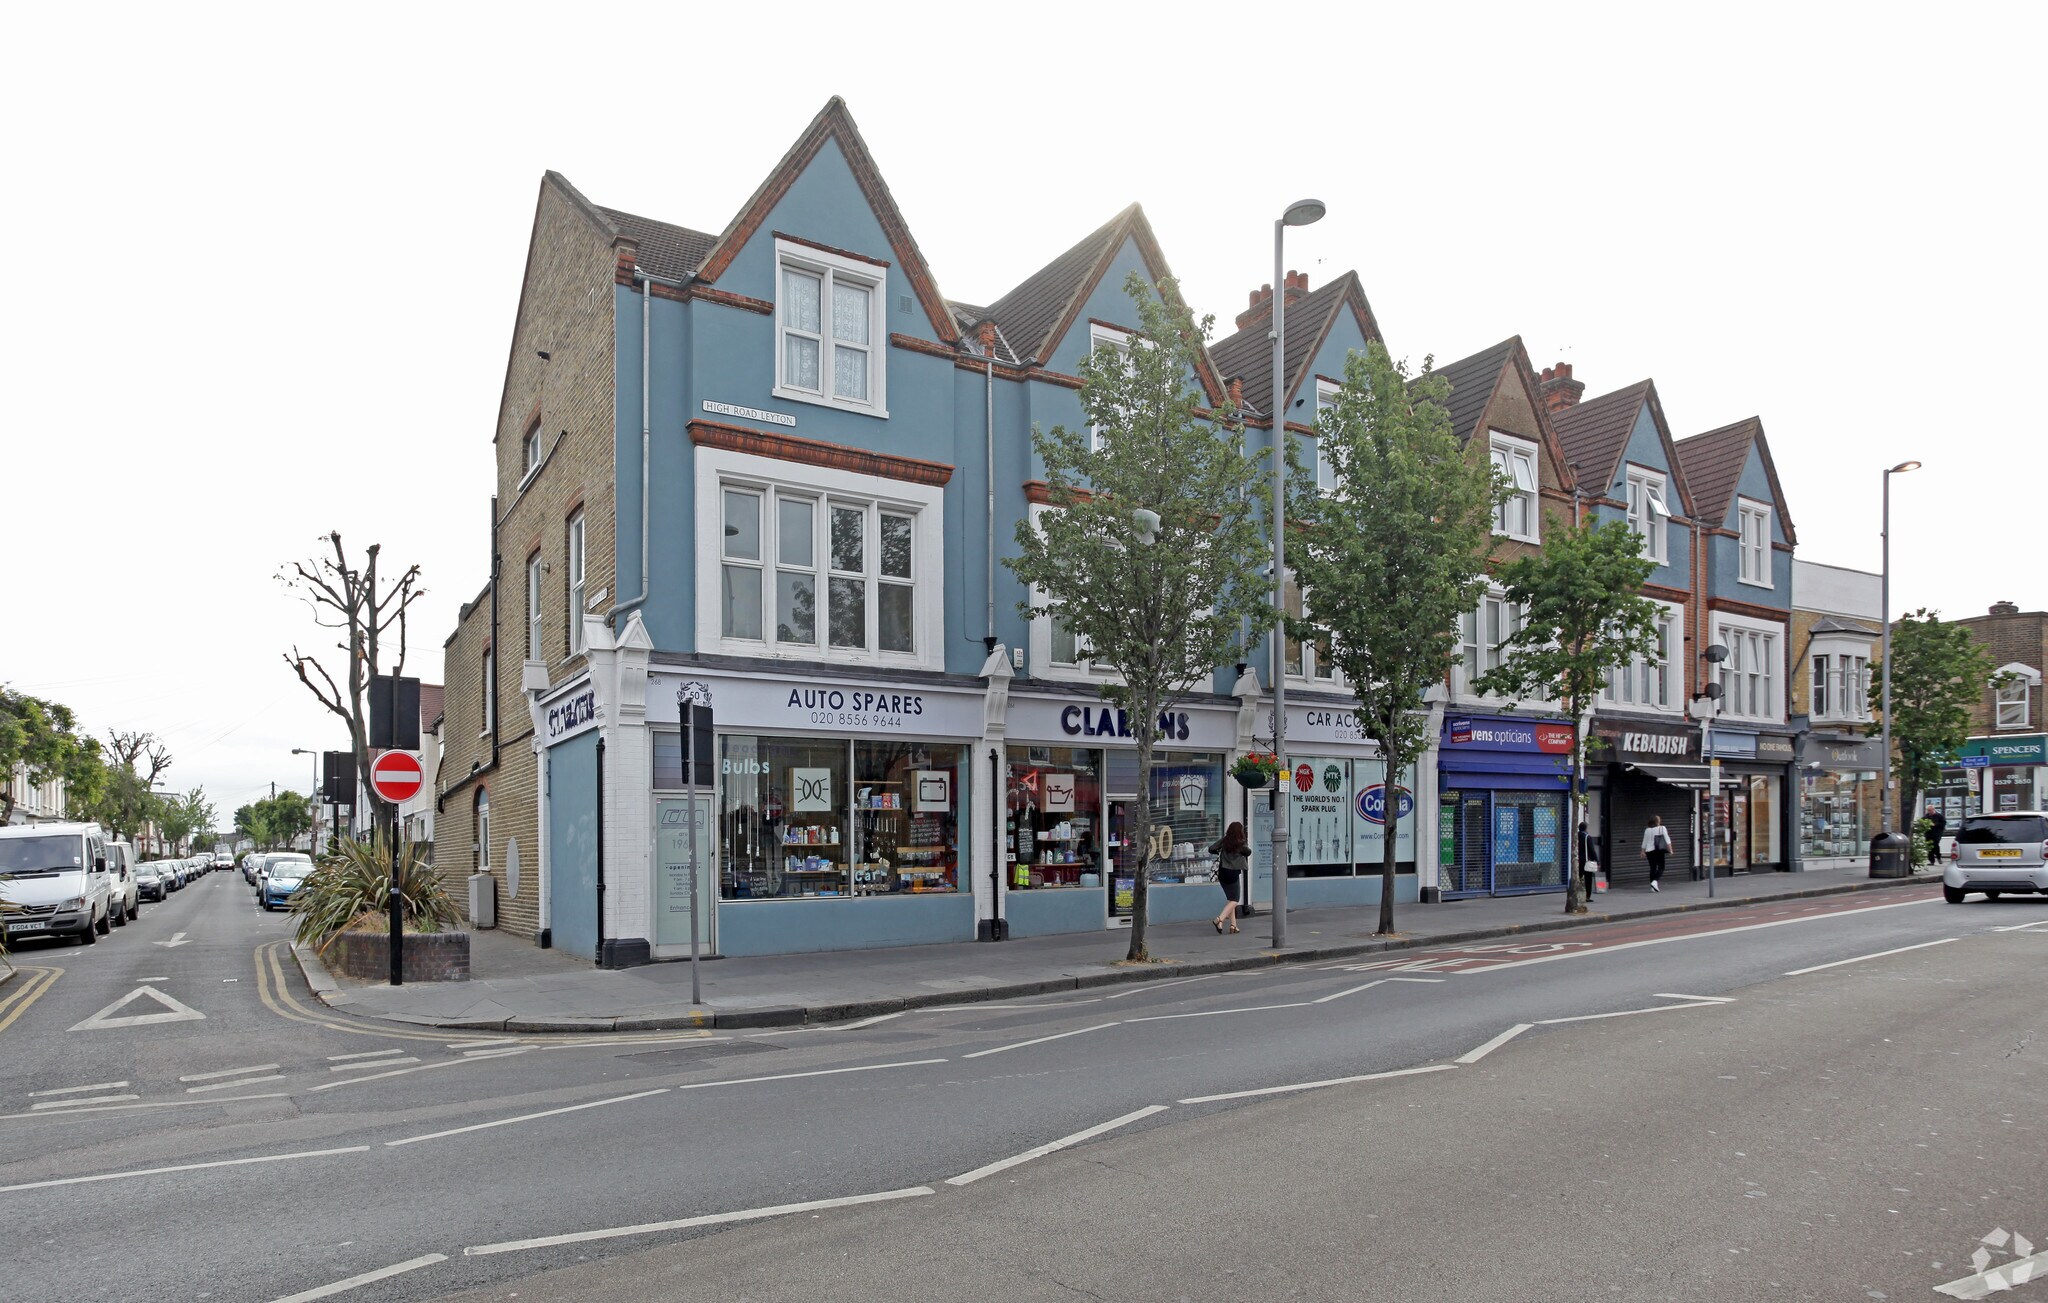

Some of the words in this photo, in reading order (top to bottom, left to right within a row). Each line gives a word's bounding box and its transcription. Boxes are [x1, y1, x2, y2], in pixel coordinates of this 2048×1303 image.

[706, 402, 730, 413] HIGH
[733, 406, 758, 418] ROAD
[761, 412, 793, 425] LEYTON
[690, 691, 700, 700] 50
[787, 688, 845, 710] AUTO
[852, 692, 923, 715] SPARES
[811, 711, 834, 724] 020
[838, 713, 868, 726] 8556
[872, 714, 901, 727] 9644
[1061, 704, 1190, 741] CLARNS
[1306, 711, 1331, 727] CAR
[1335, 730, 1348, 739] 020
[1471, 729, 1493, 741] vens
[1494, 729, 1532, 746] opticians
[1623, 732, 1688, 755] KEBABISH
[1992, 744, 2041, 755] SPENCERS
[722, 758, 770, 775] Bulbs
[1325, 771, 1340, 780] NTK
[1293, 795, 1304, 803] THE
[1304, 795, 1331, 803] WORLD'S
[1365, 794, 1409, 812] Coa
[1301, 805, 1320, 813] SPARK
[1321, 805, 1336, 813] PLUG
[672, 839, 689, 849] 196
[854, 869, 878, 882] Car
